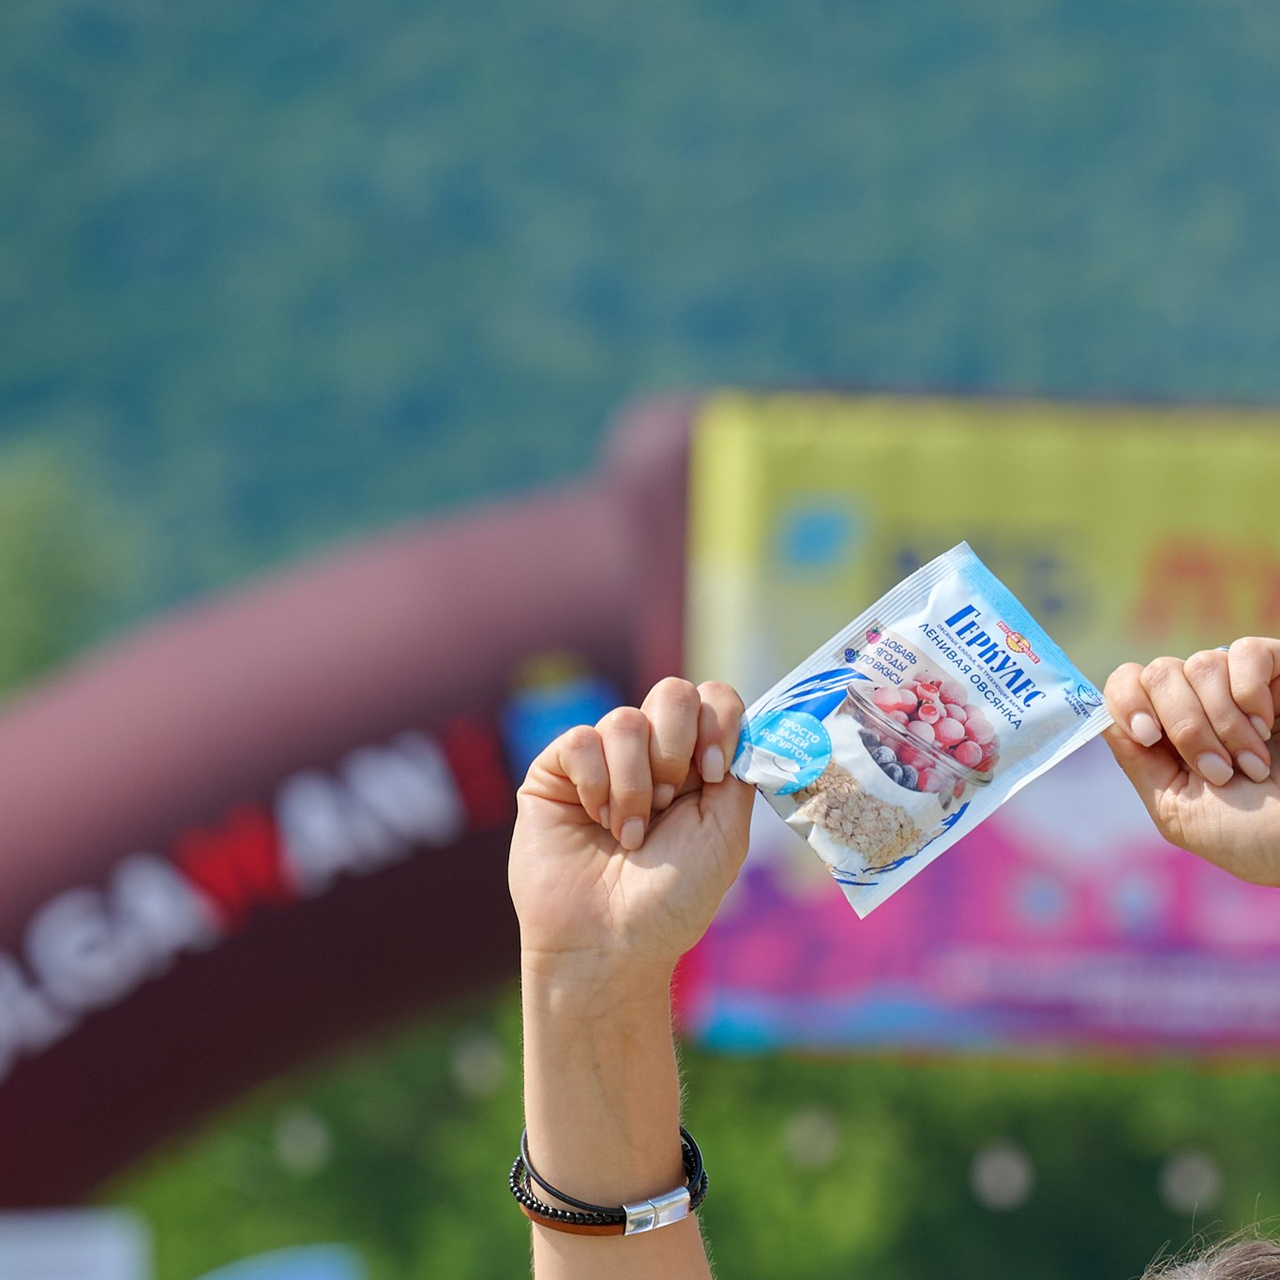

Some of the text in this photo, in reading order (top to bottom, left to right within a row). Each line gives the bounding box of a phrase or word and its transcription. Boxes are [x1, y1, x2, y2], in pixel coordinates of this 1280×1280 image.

[874, 647, 908, 673] ЯГОДЫ
[881, 637, 917, 665] ДОБАВЬ
[859, 654, 904, 685] ПО ВКУСУ
[919, 623, 1022, 730] ЛЕНИВАЯ ОВСЯНКА
[775, 728, 810, 749] ЗАЛЕЙ
[779, 717, 820, 743] ПРОСТО
[760, 728, 813, 764] ЙОГУРТОМ
